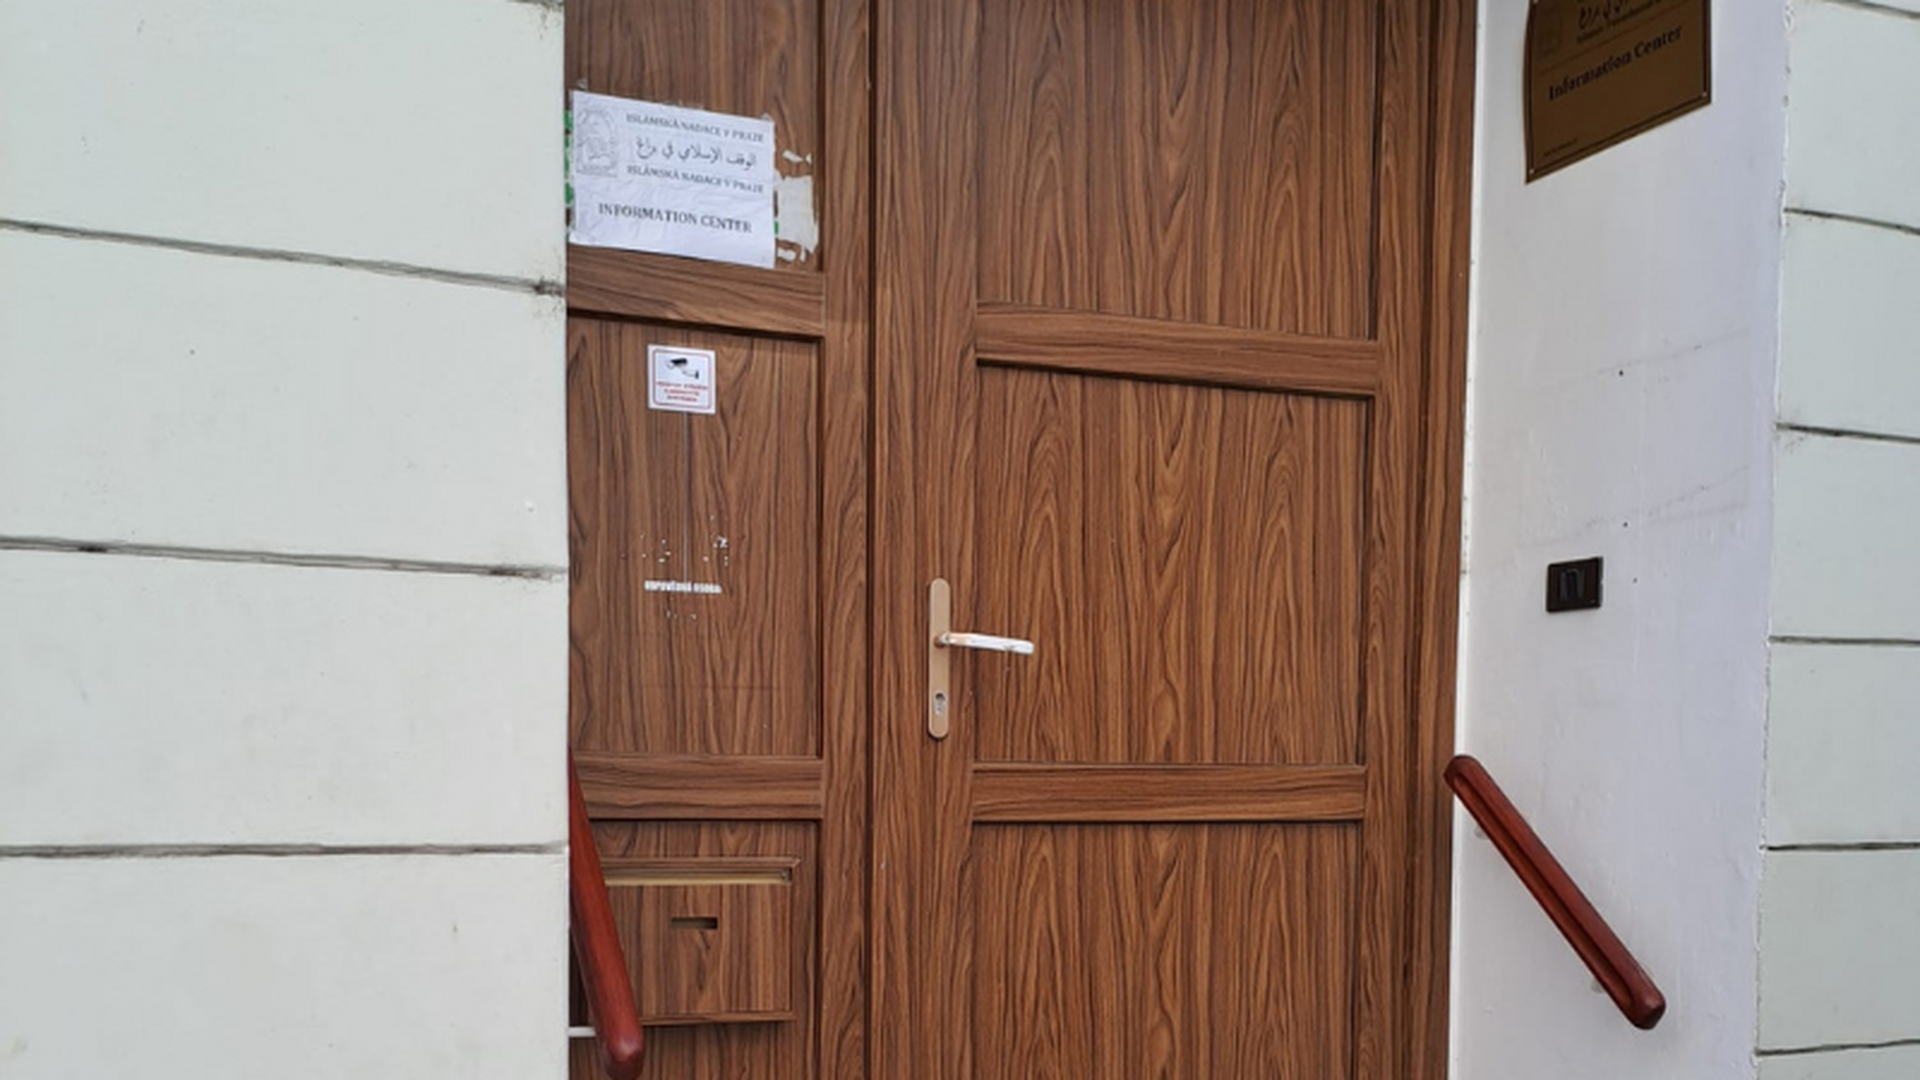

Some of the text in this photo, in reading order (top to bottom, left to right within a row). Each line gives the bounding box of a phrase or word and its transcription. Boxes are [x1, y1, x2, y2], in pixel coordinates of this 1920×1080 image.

[1549, 26, 1683, 100] Information Center
[626, 113, 679, 129] ISLÁMSKÁ
[680, 121, 721, 136] NADACE
[723, 128, 729, 138] V
[662, 140, 674, 158] في
[726, 152, 756, 171] الوقف
[627, 165, 764, 193] ISLÁMSKÁ NADACE V PRAZE
[598, 202, 752, 234] INFORMATION CENTER
